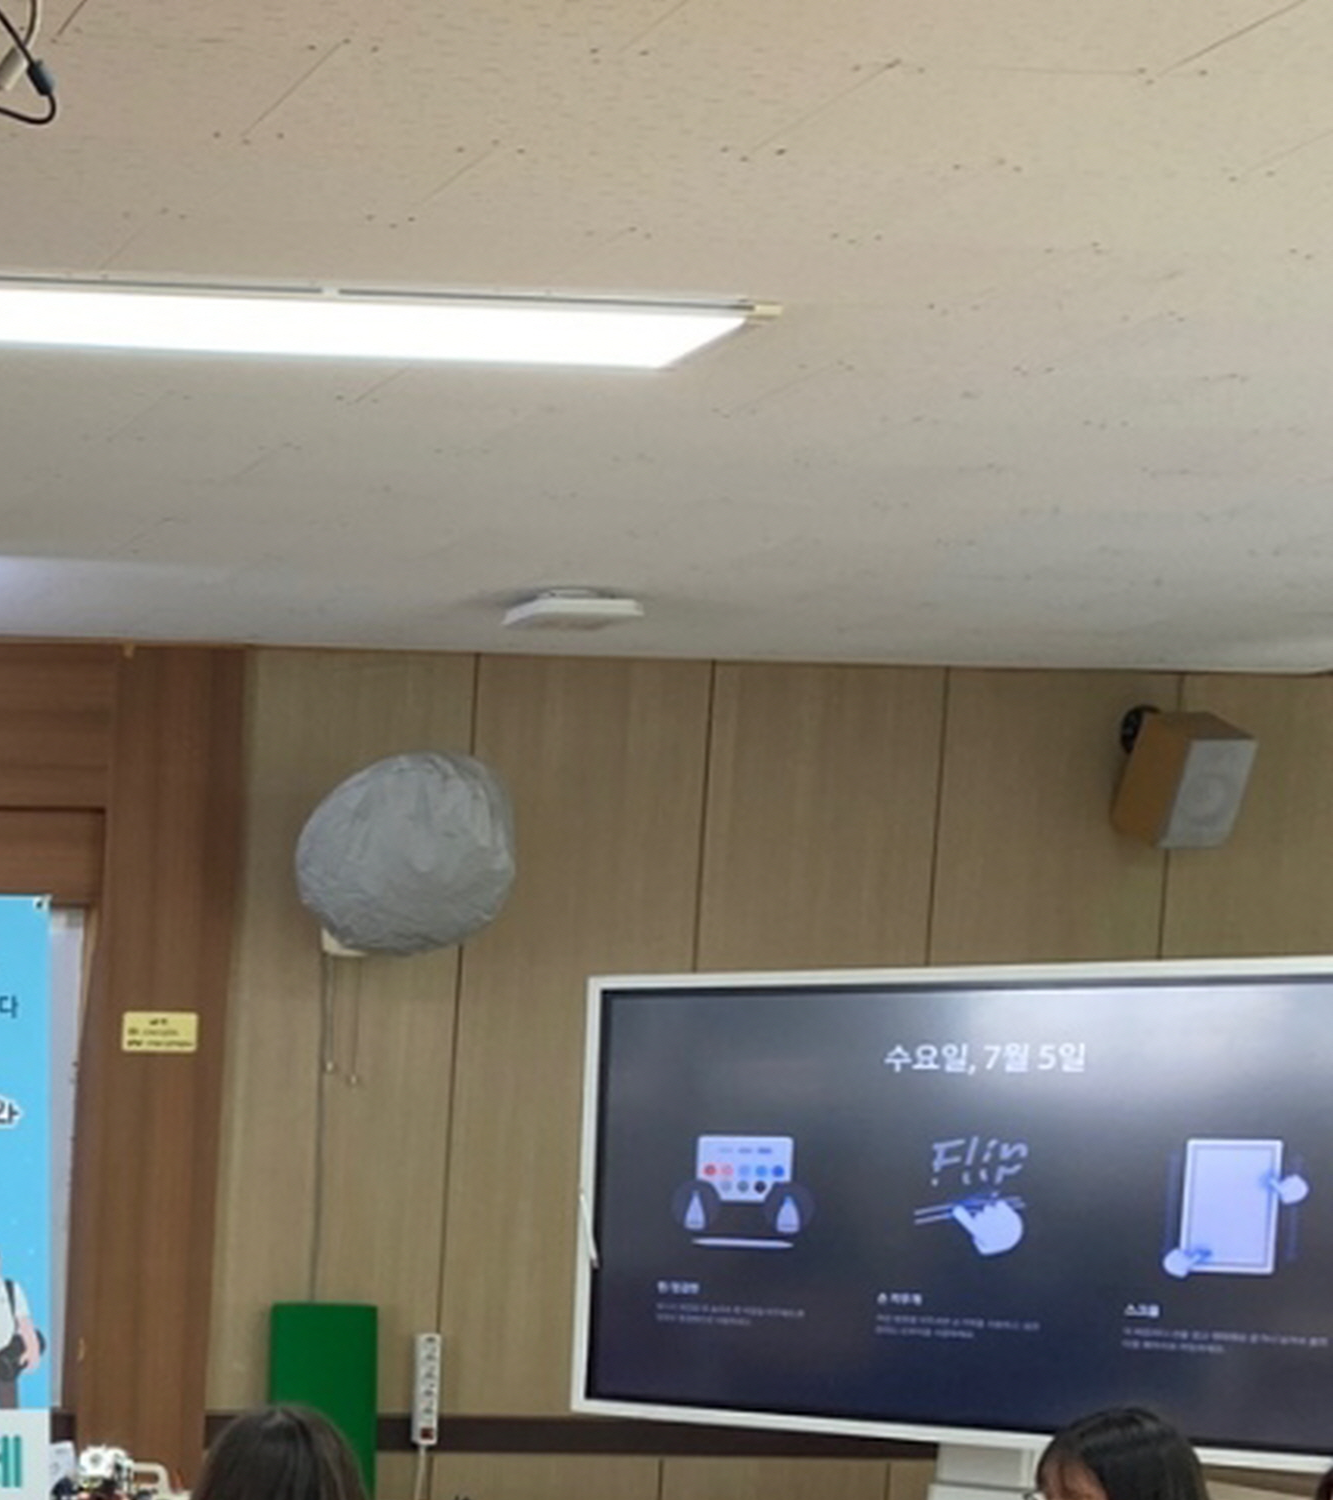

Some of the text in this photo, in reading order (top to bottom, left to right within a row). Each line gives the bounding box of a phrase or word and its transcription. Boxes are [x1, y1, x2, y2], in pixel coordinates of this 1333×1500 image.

[883, 1042, 1087, 1075] 수요일, 7월 5일
